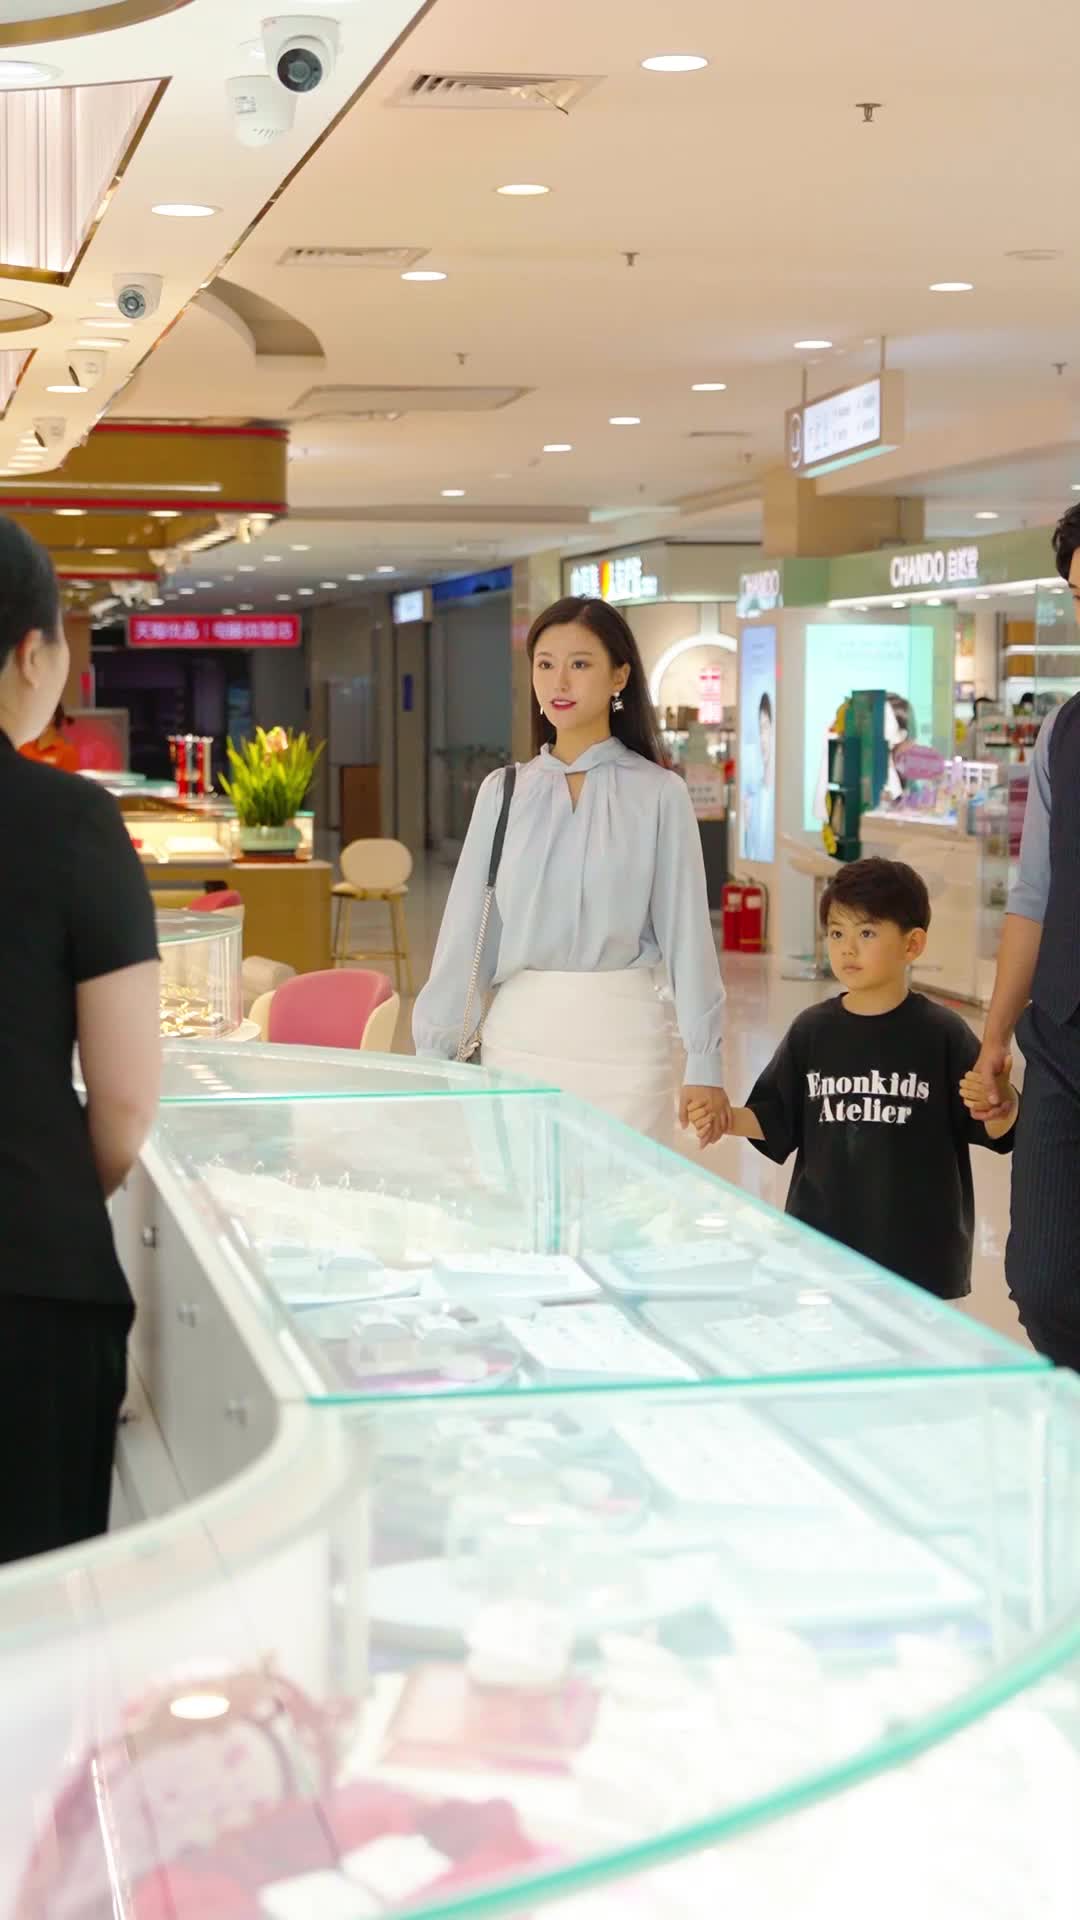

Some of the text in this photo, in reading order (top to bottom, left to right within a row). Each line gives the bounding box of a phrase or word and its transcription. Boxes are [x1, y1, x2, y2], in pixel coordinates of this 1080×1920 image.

[890, 551, 945, 587] CHANDO
[806, 1069, 930, 1099] Enonkids
[818, 1096, 912, 1124] Atelier
